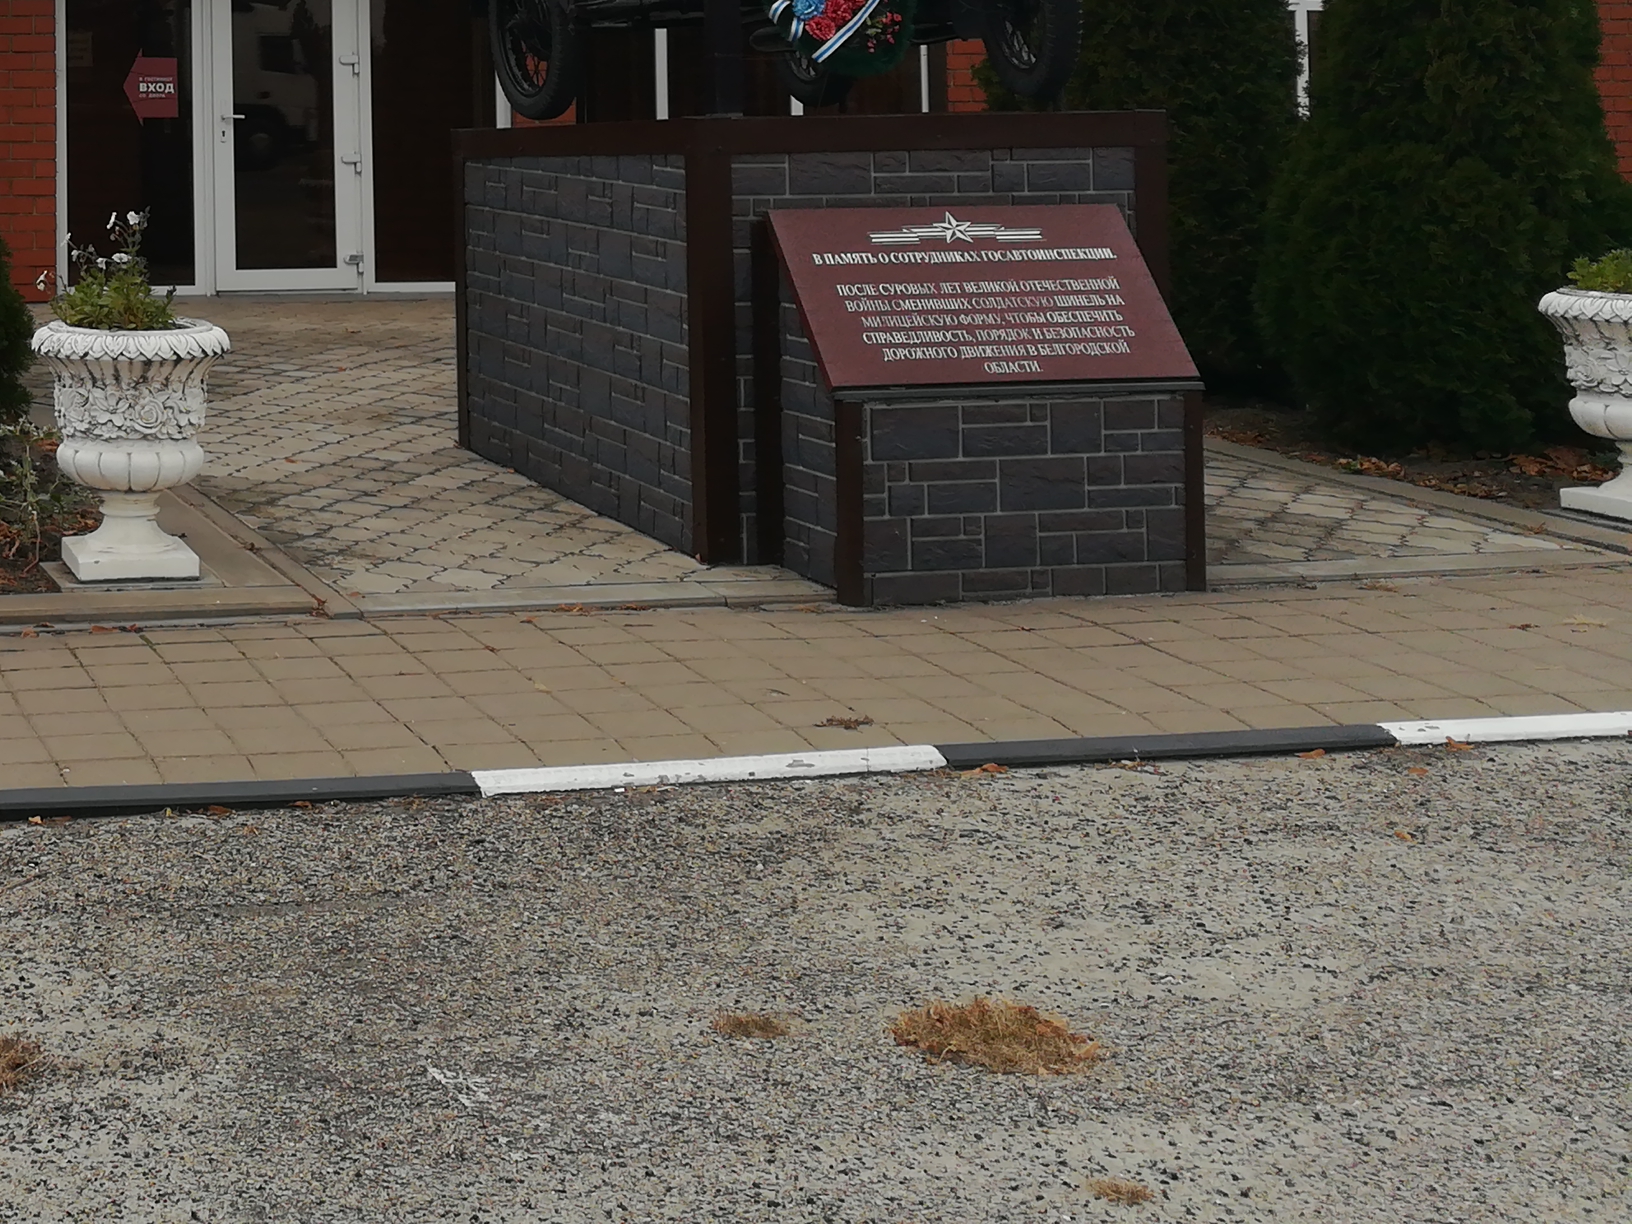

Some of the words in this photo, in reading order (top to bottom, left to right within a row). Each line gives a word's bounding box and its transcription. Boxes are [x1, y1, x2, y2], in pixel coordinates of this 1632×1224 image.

[139, 82, 175, 94] ВХОД
[812, 253, 823, 265] В
[823, 252, 878, 265] ПАМЯТЬ
[878, 252, 889, 264] О
[890, 251, 982, 264] СОТРУДНИКАХ
[981, 248, 1117, 262] ГОСАВТОИНСПЕКЦИИ.
[836, 283, 879, 296] ПОСЛЕ
[879, 282, 938, 296] СУРОВЫХ
[940, 282, 961, 294] ЛЕТ
[963, 279, 1018, 293] ВЕЛИКОЙ
[1019, 276, 1121, 292] ОТЕЧЕСТВЕННОЙ
[844, 297, 891, 312] ВОЙНЫ
[891, 298, 972, 311] СМЕНИВШИХ
[972, 296, 1054, 310] СОЛДАТСКУЮ
[1053, 294, 1106, 308] ШИНЕЛЬ
[1104, 294, 1126, 306] НА
[861, 312, 958, 328] МИЛИЦЕЙСКУЮ
[958, 312, 1006, 326] ФОРМУ,
[1005, 311, 1047, 325] ЧТОБЫ
[1046, 310, 1124, 323] ОБЕСПЕЧИТЬ
[862, 329, 977, 345] СПРАВЕДЛИВОСТЬ,
[975, 328, 1032, 342] ПОРЯДОК
[1031, 328, 1043, 340] И
[1043, 325, 1136, 339] БЕЗОПАСНОСТЬ
[882, 346, 958, 362] ДОРОЖНОГО
[959, 344, 1027, 359] ДВИЖЕНИЯ
[1026, 344, 1038, 356] В
[1037, 339, 1131, 356] БЕЛГОРОДСКОЙ
[984, 360, 1044, 374] ОБЛАСТИ.
